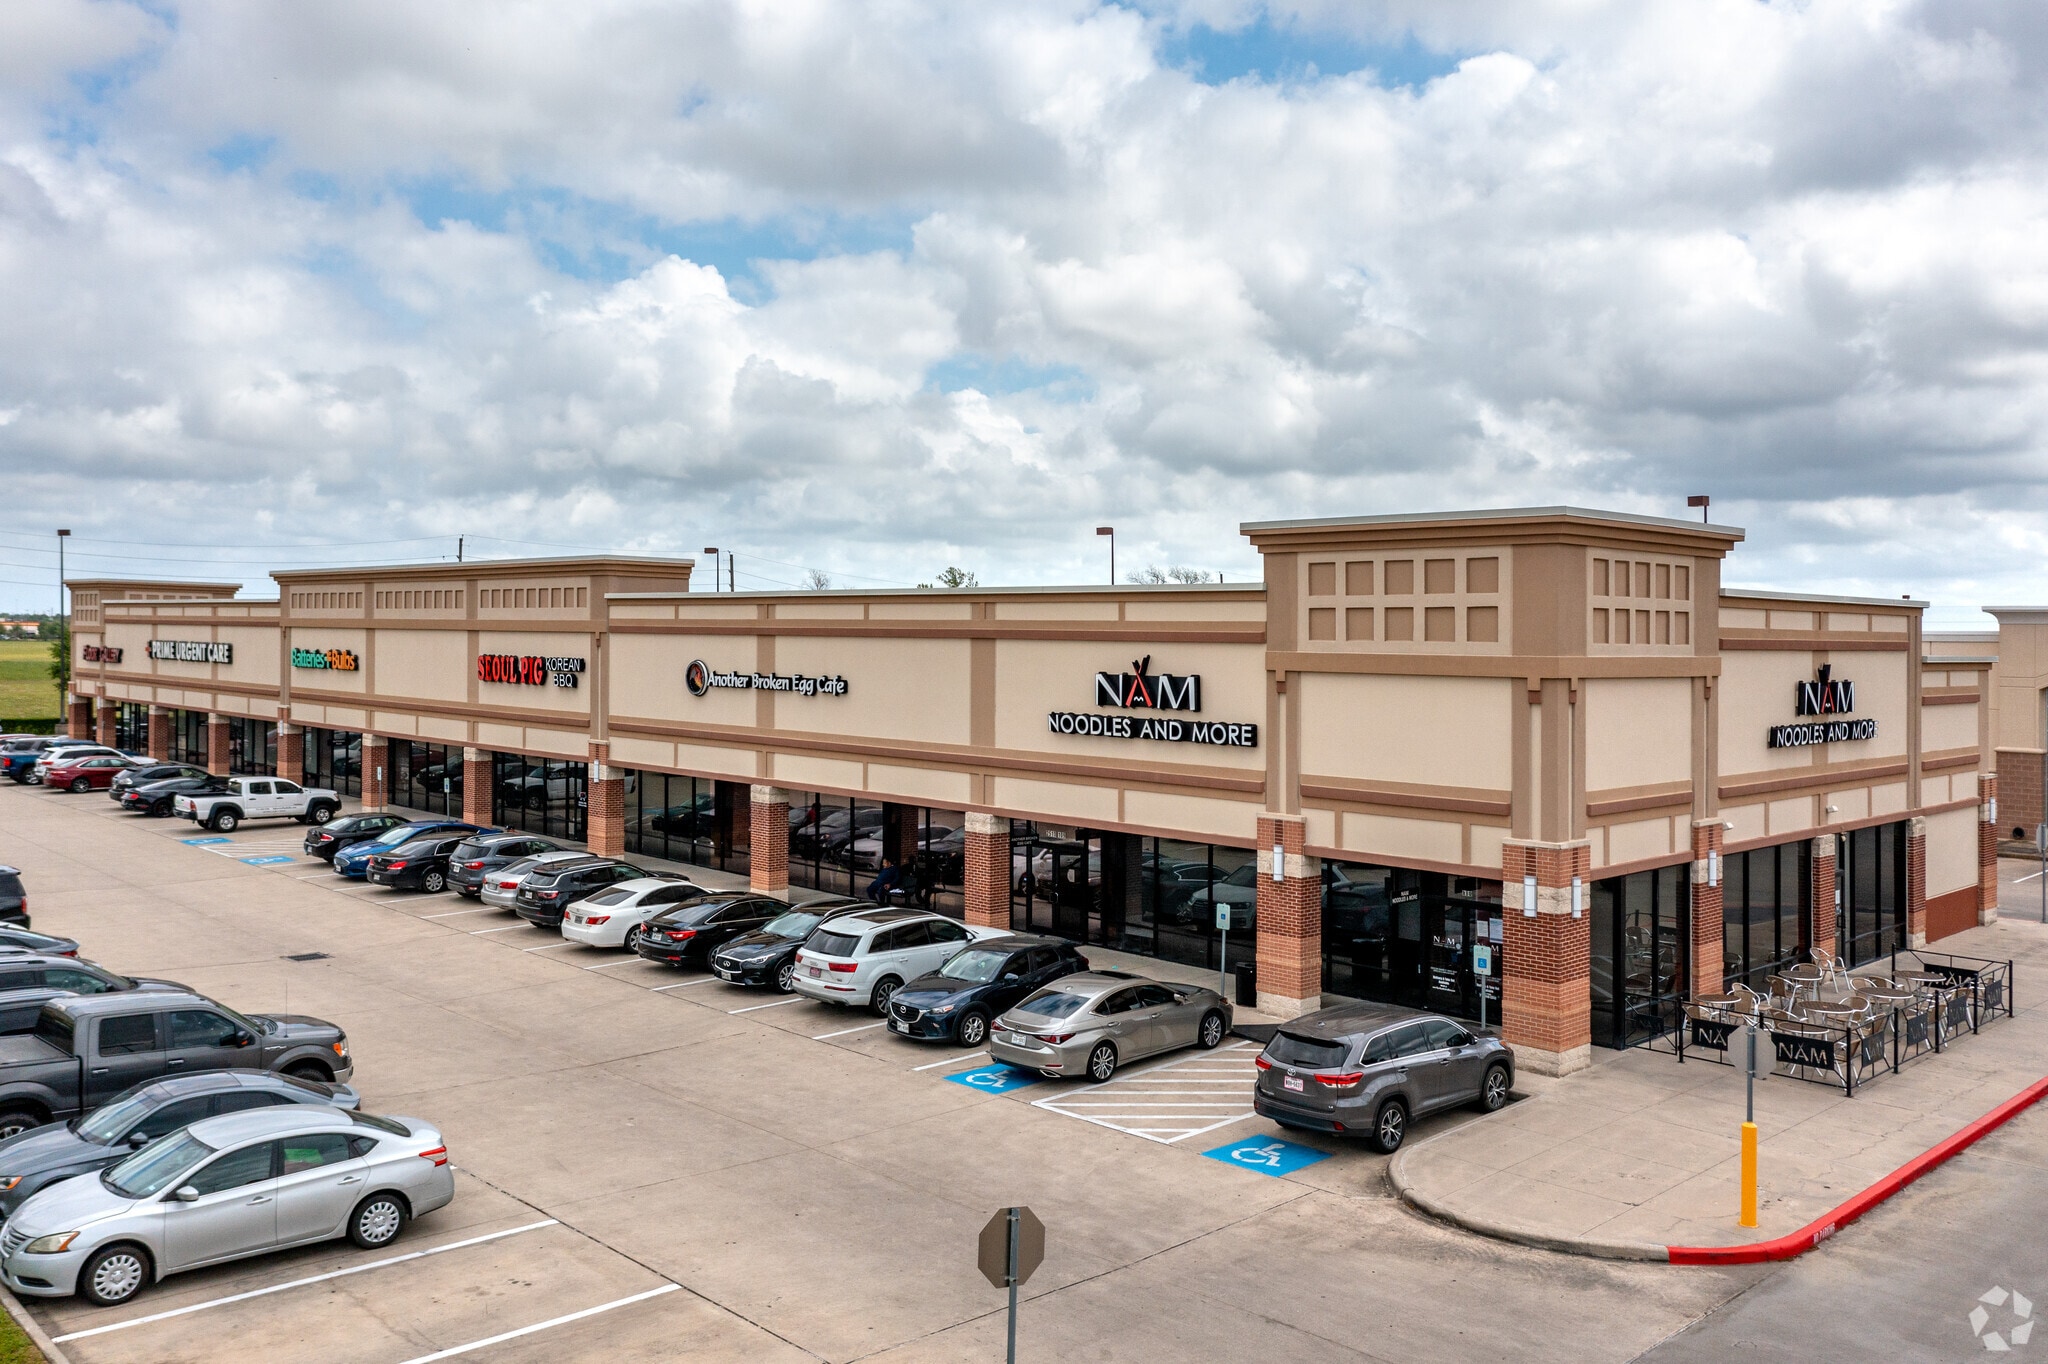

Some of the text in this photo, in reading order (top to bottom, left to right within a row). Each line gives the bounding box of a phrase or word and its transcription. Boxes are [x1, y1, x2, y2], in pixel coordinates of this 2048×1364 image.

[152, 641, 229, 663] PRIME URGENT CARE
[292, 648, 325, 669] Batteries
[331, 649, 355, 670] Bulbs
[478, 655, 580, 684] SEOUL PIG KOREAN
[553, 674, 573, 687] BBQ
[708, 672, 845, 695] Another Broken Egg Cafe
[1095, 660, 1199, 711] NAM
[1804, 672, 1855, 714] NAM
[1048, 714, 1252, 746] NOODLES AND MORE
[1776, 720, 1879, 748] NOODLES AND MORE
[1698, 1027, 1727, 1046] NA
[1778, 1041, 1828, 1065] NAM
